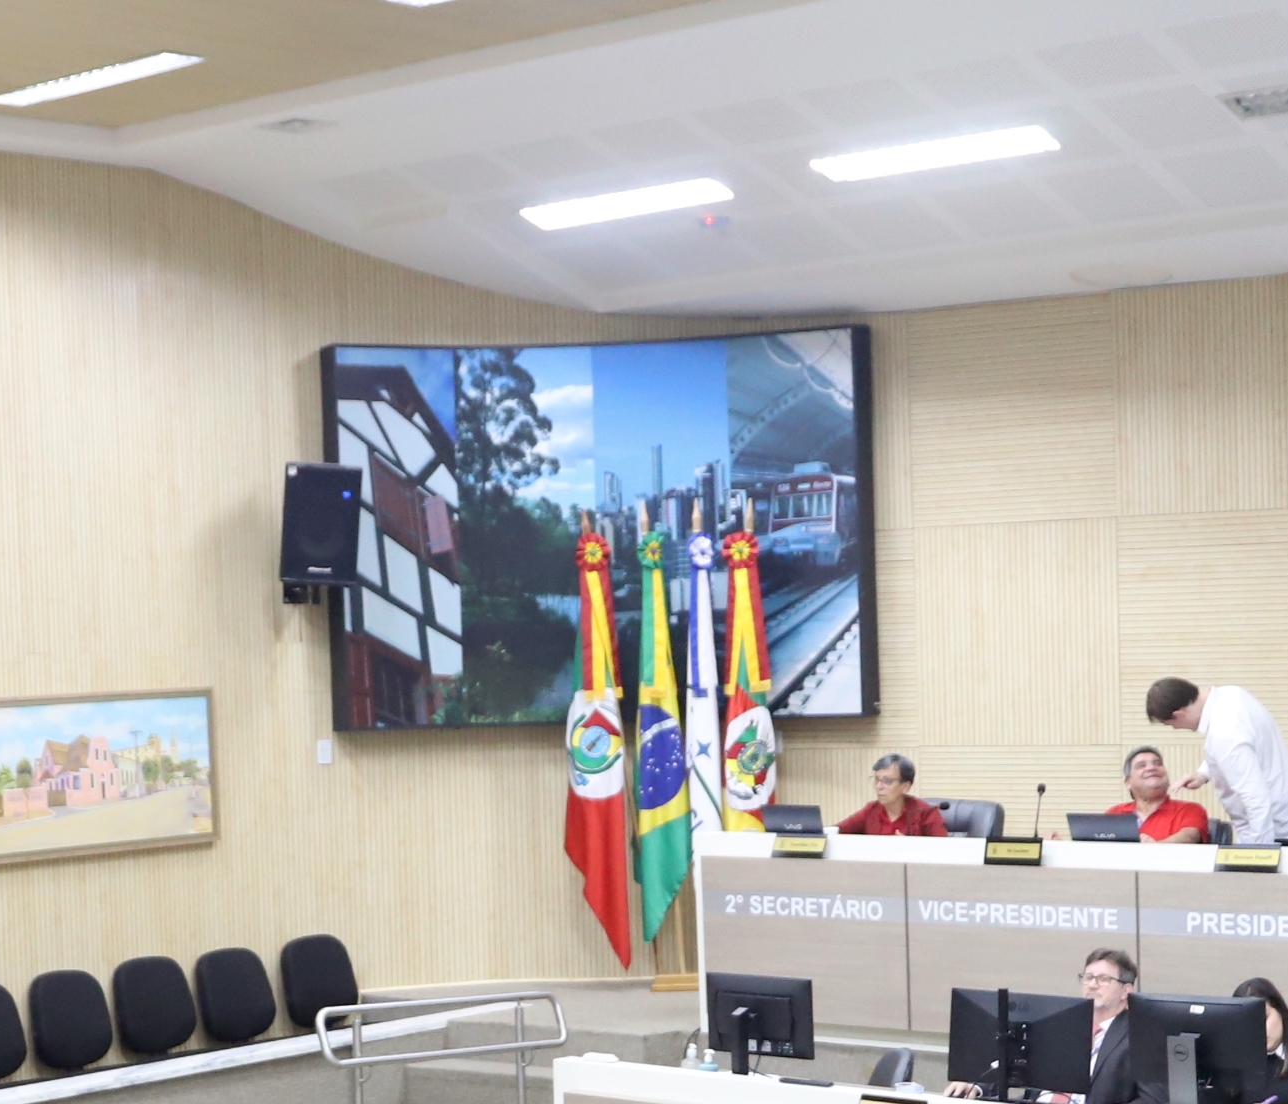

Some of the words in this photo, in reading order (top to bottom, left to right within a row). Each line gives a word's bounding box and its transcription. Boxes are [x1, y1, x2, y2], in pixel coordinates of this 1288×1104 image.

[725, 894, 744, 913] 2º
[749, 895, 884, 921] SECRETÁRIO
[918, 899, 1119, 930] VICE-PRESIDENTE
